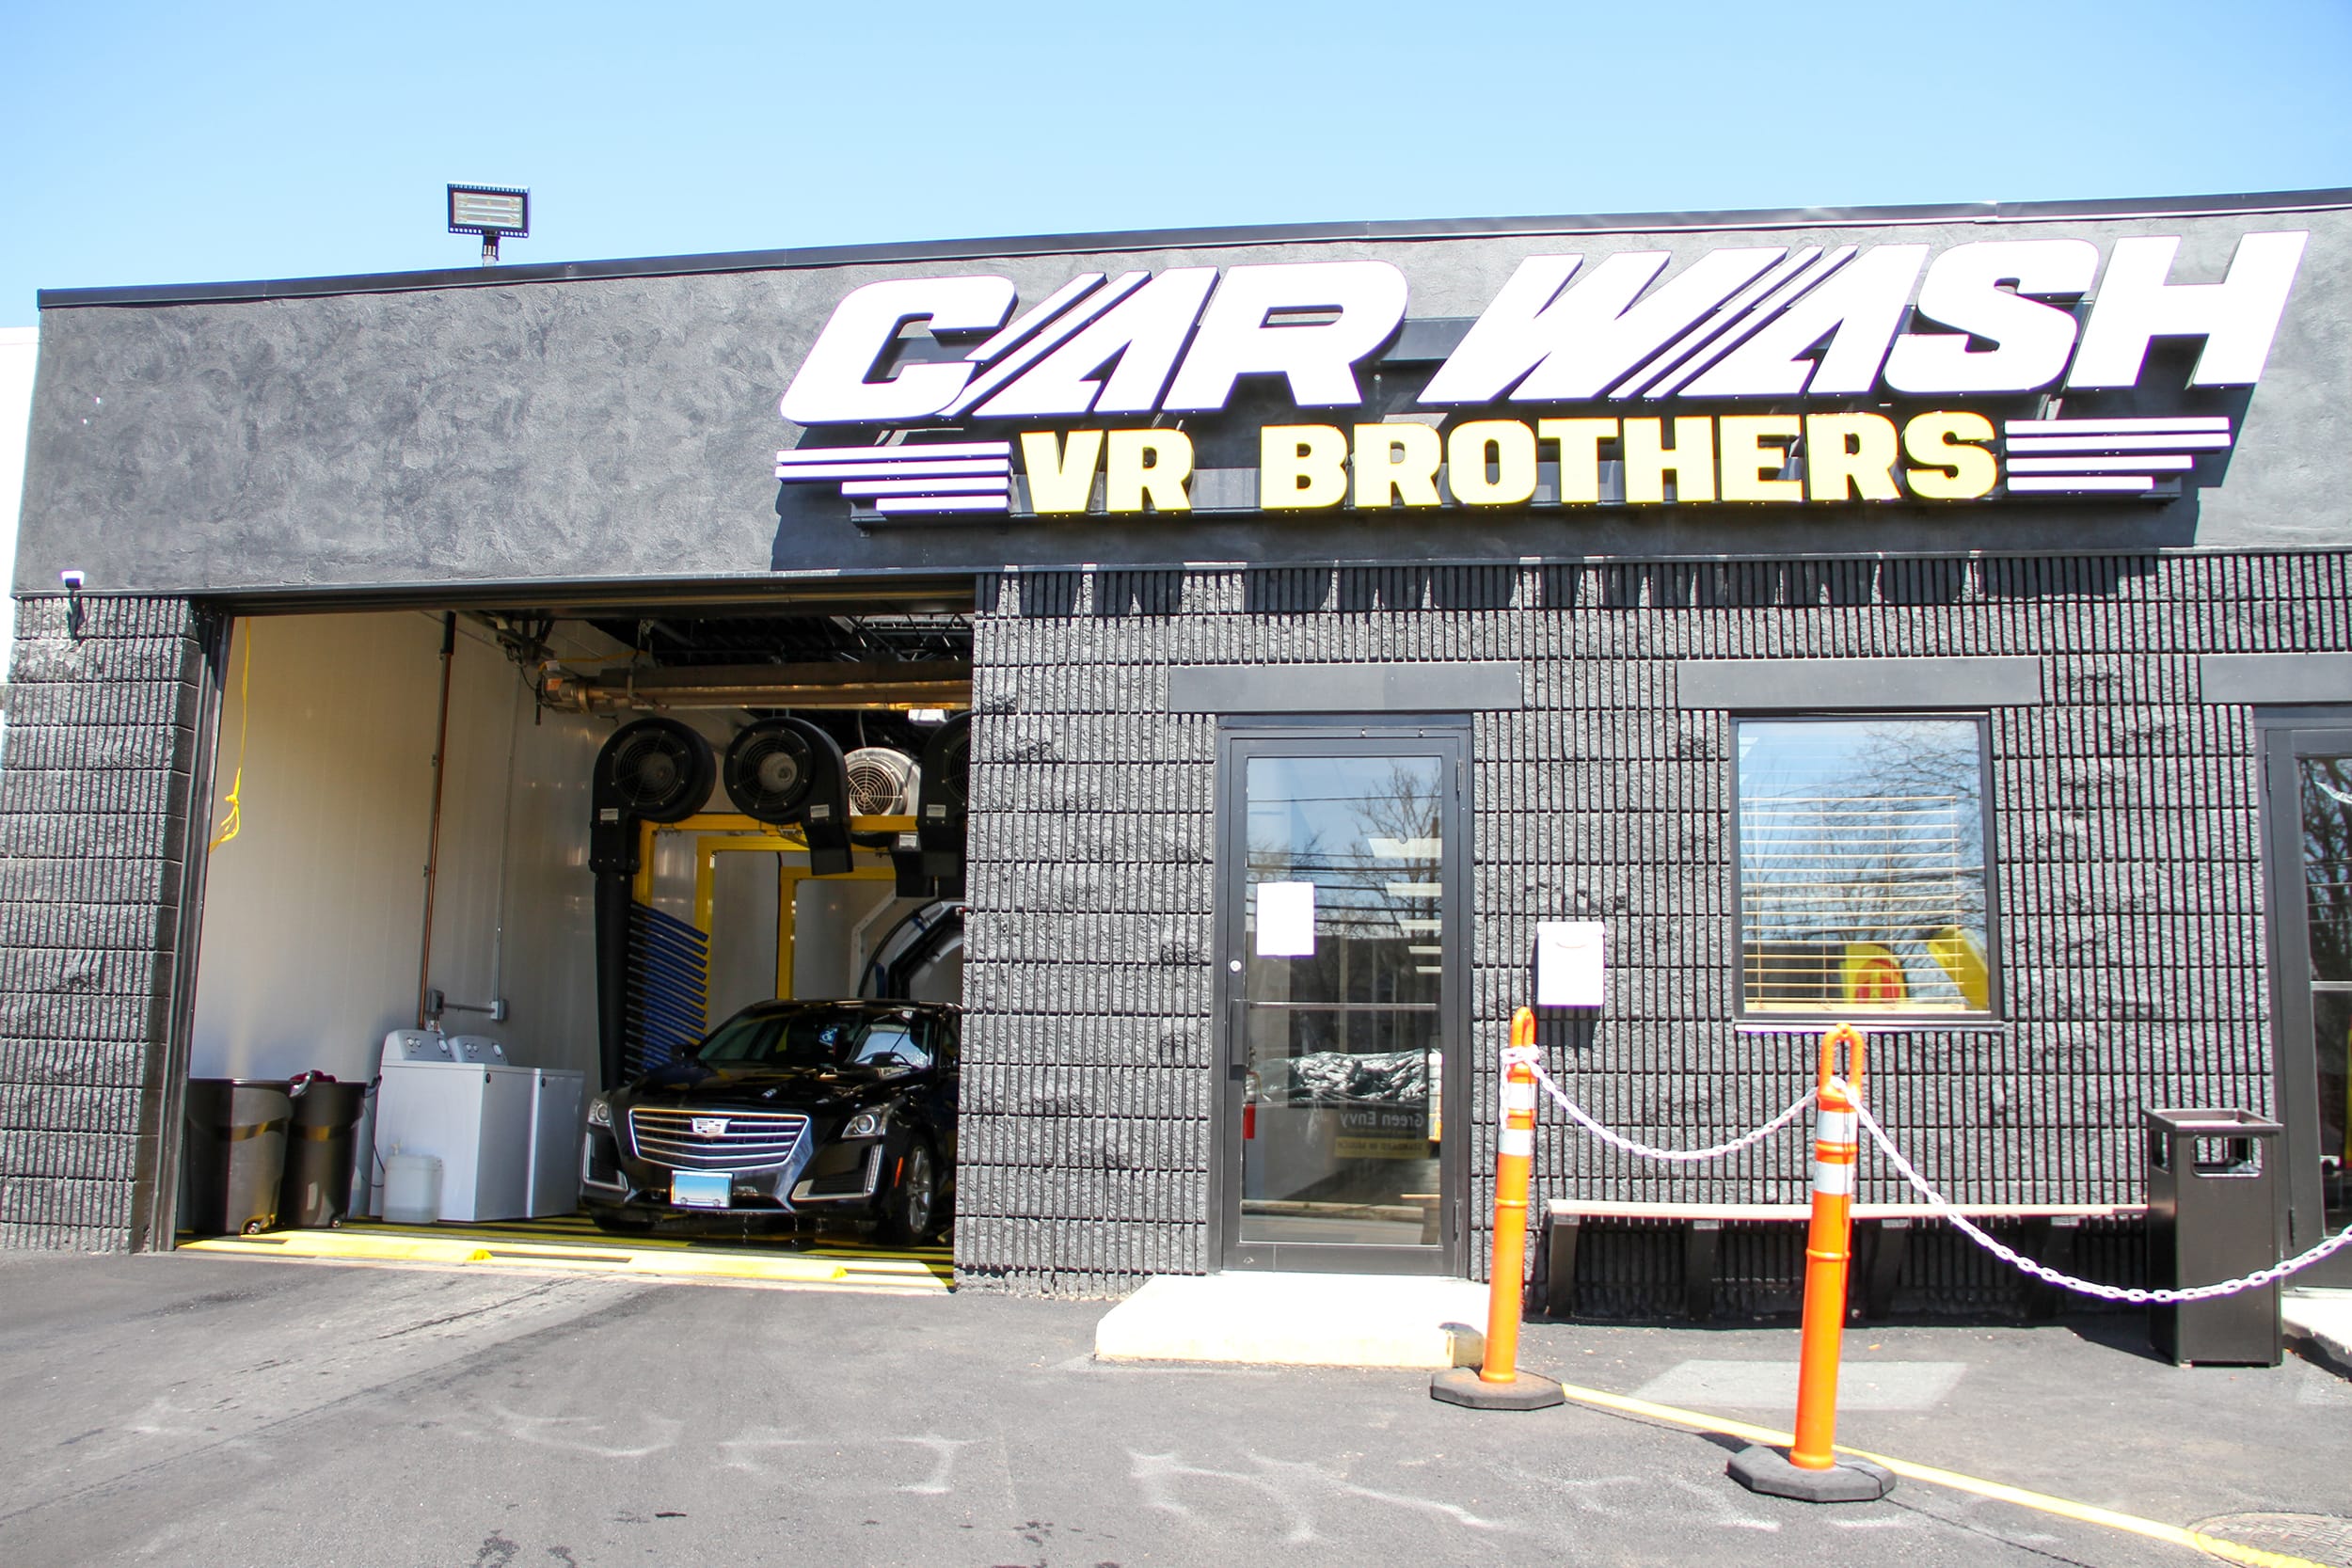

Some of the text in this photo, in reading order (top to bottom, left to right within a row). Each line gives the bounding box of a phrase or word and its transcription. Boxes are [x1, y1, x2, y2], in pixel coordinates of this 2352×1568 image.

[780, 230, 2311, 425] CAR WASH
[1019, 412, 1998, 515] VR BROTHERS
